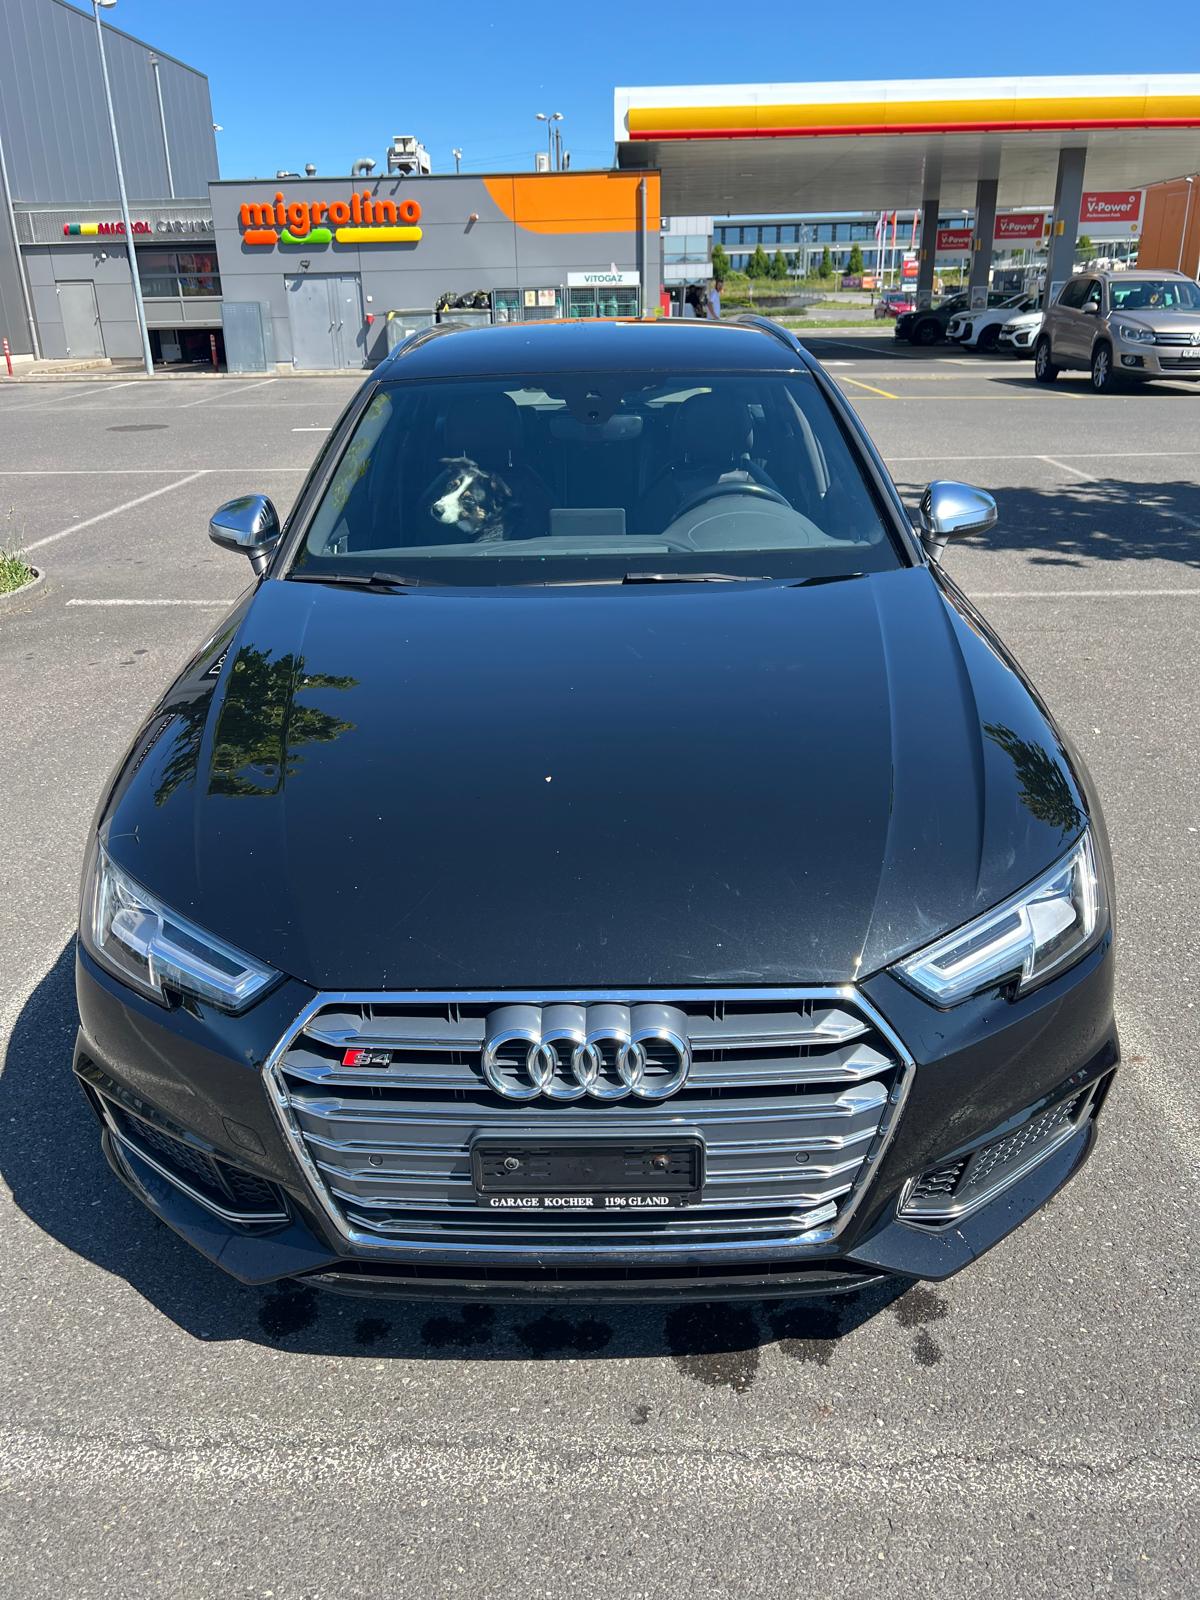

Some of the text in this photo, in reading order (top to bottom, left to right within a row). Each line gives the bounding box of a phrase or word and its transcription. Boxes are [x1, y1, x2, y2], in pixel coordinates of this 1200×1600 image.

[240, 191, 422, 235] migrolino
[584, 274, 623, 283] VITOGAZ
[354, 1052, 390, 1066] S4
[490, 1196, 670, 1207] GARAGE KOCHER 1196 GLAND
